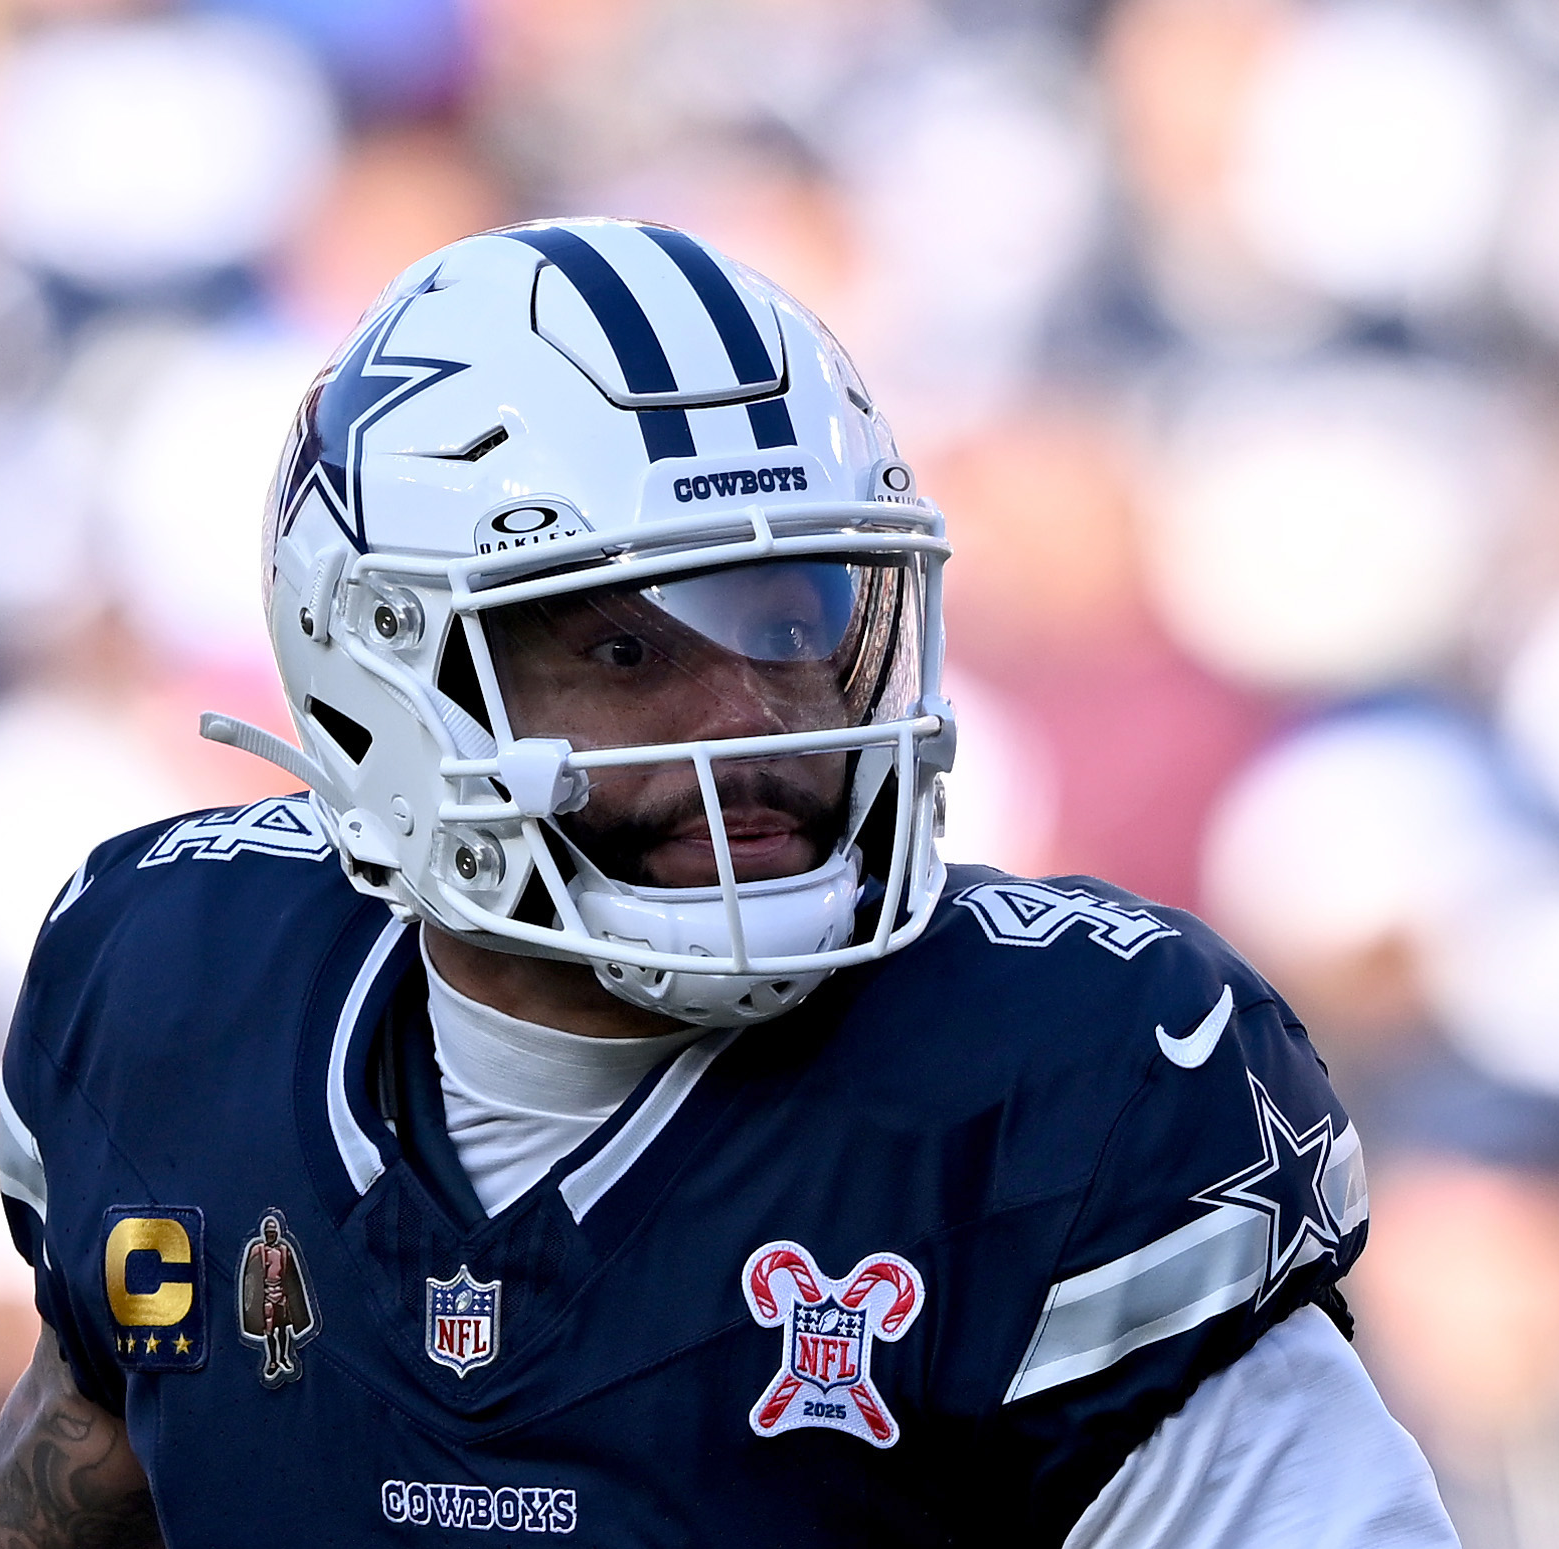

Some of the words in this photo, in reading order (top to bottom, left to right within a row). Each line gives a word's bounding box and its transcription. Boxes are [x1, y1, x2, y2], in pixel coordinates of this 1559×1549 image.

[673, 466, 808, 503] COWBOYS
[136, 795, 333, 870] 4
[952, 880, 1182, 961] 4
[105, 1217, 194, 1327] C
[436, 1317, 487, 1359] NFL
[796, 1334, 856, 1383] NFL
[802, 1400, 847, 1420] 2025
[381, 1479, 578, 1534] COWBOYS
